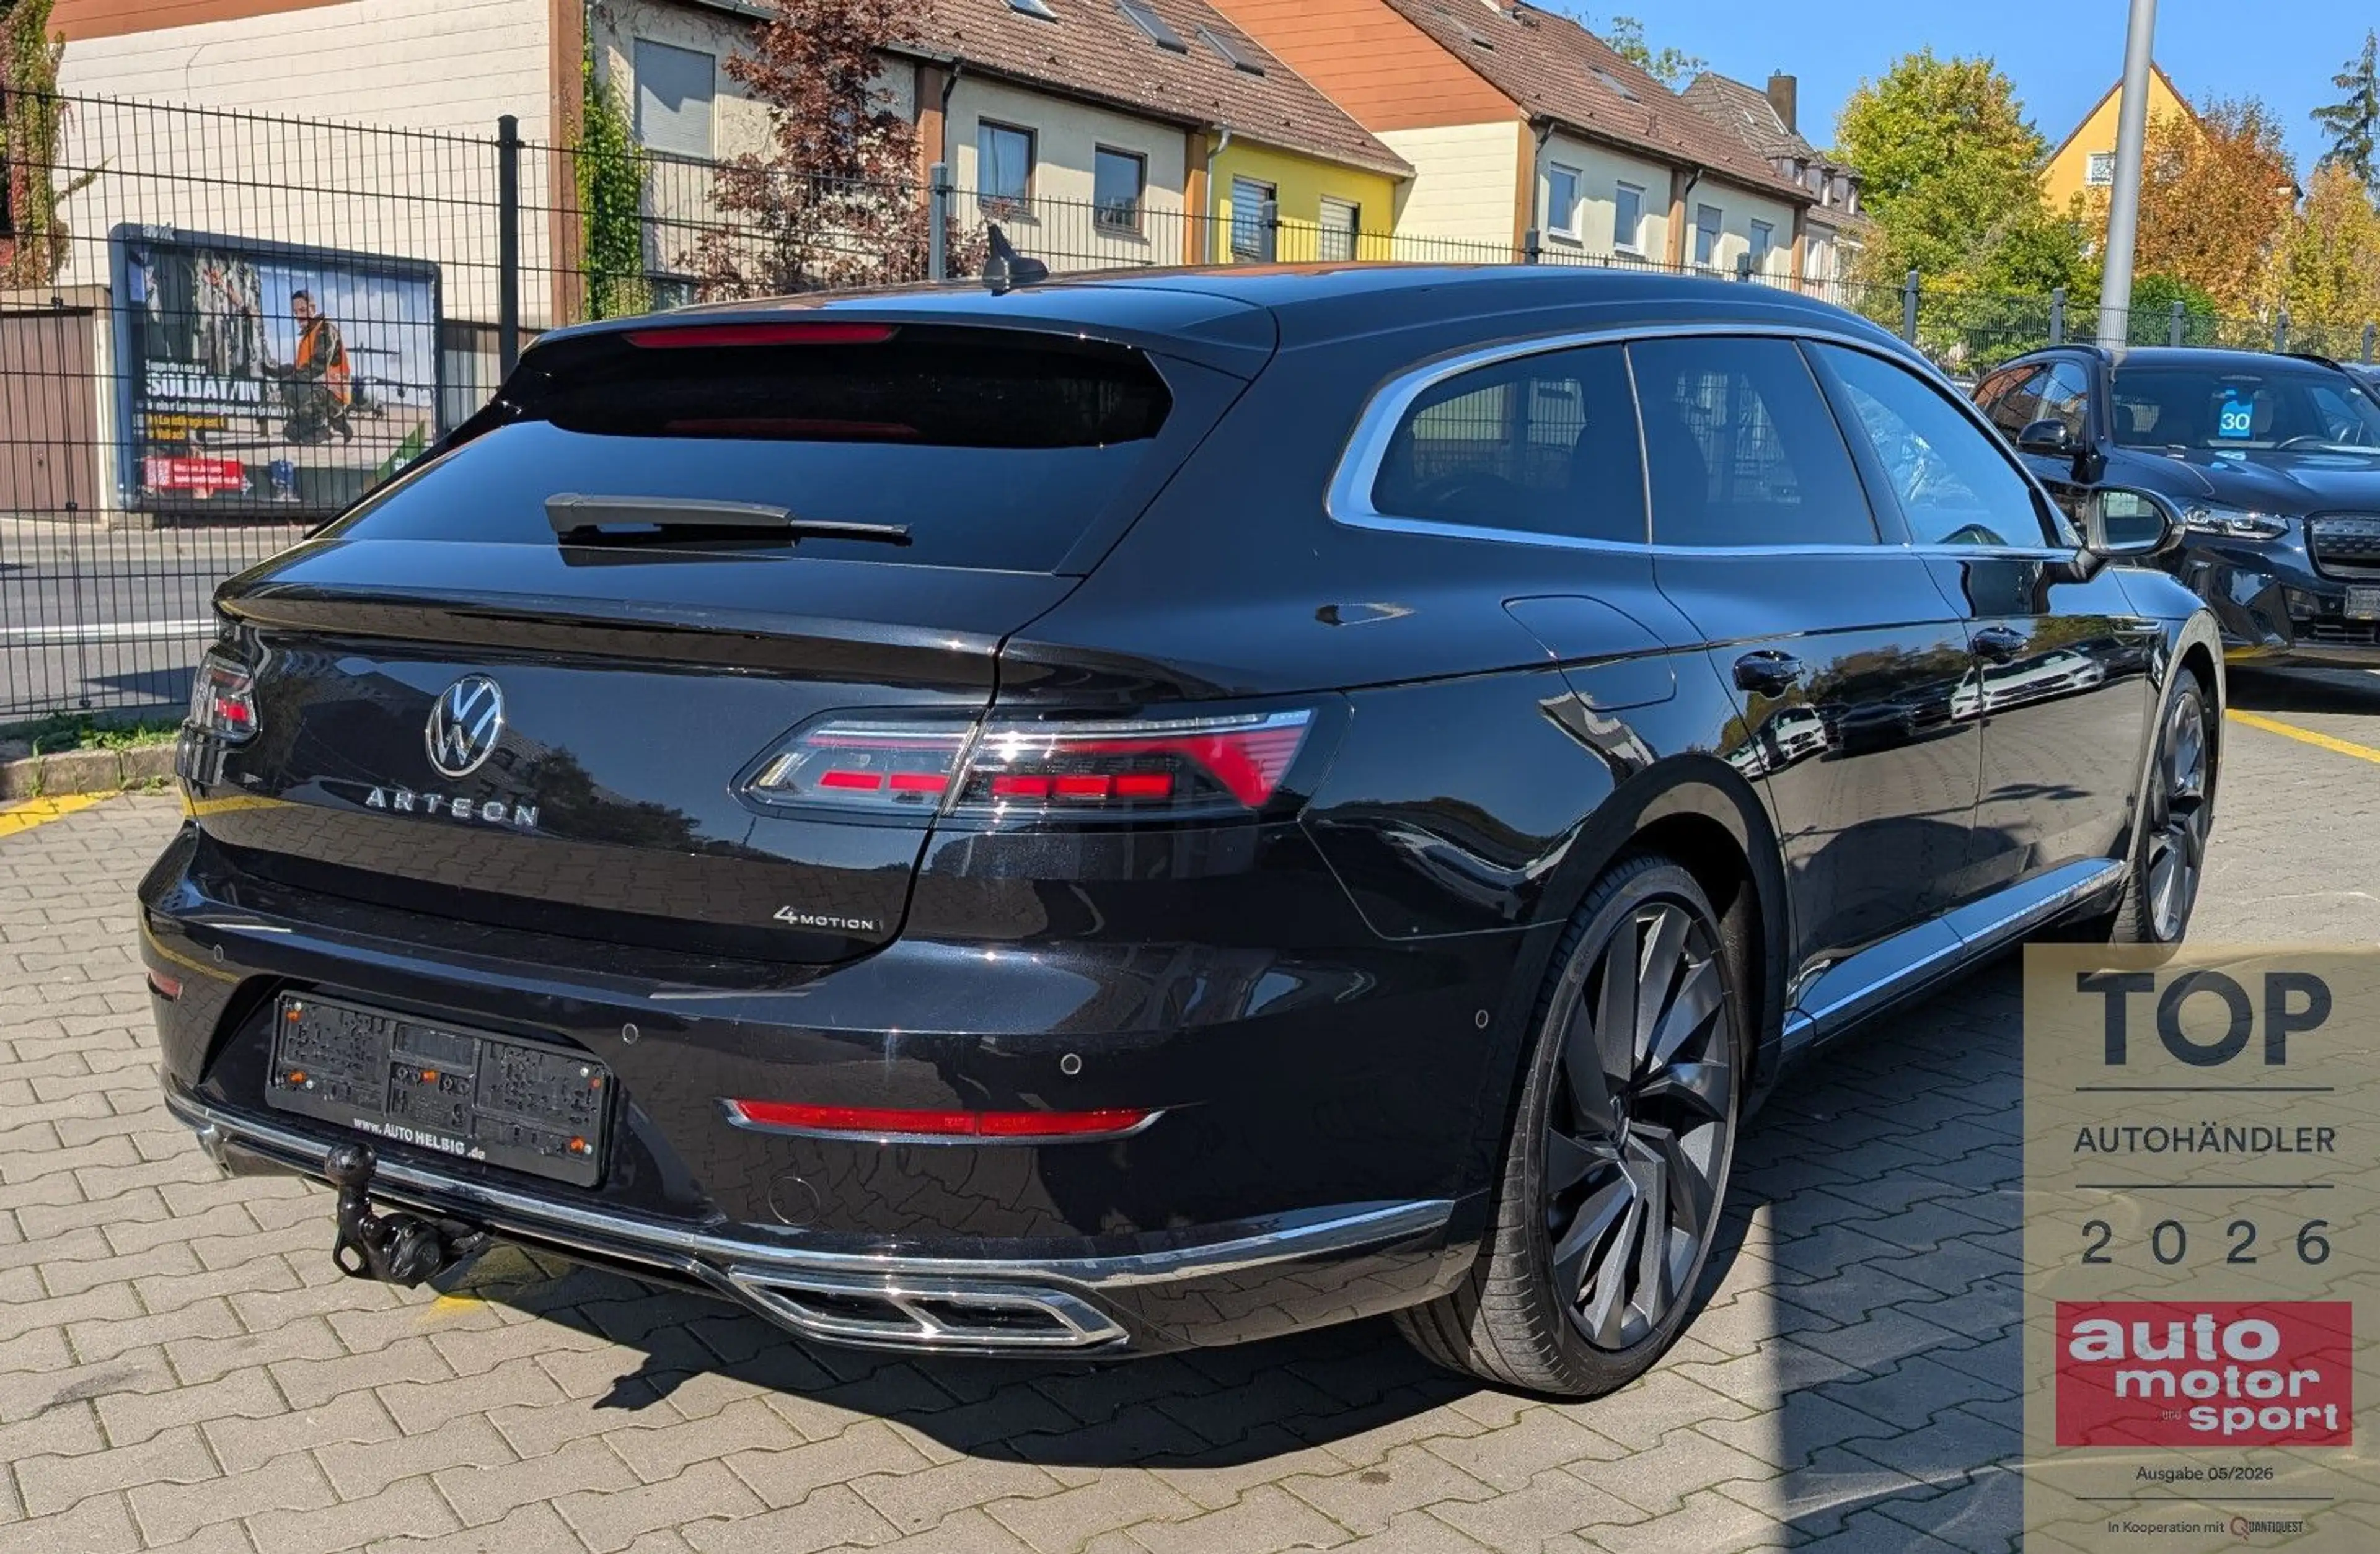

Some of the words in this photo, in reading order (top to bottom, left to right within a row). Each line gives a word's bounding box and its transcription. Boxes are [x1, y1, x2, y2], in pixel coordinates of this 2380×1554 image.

[2221, 413, 2250, 430] 30
[365, 786, 539, 826] ARTEON
[774, 905, 873, 929] 4MOTION
[354, 1118, 382, 1134] www.
[384, 1123, 413, 1141] AUTO
[415, 1130, 465, 1155] HELBIG
